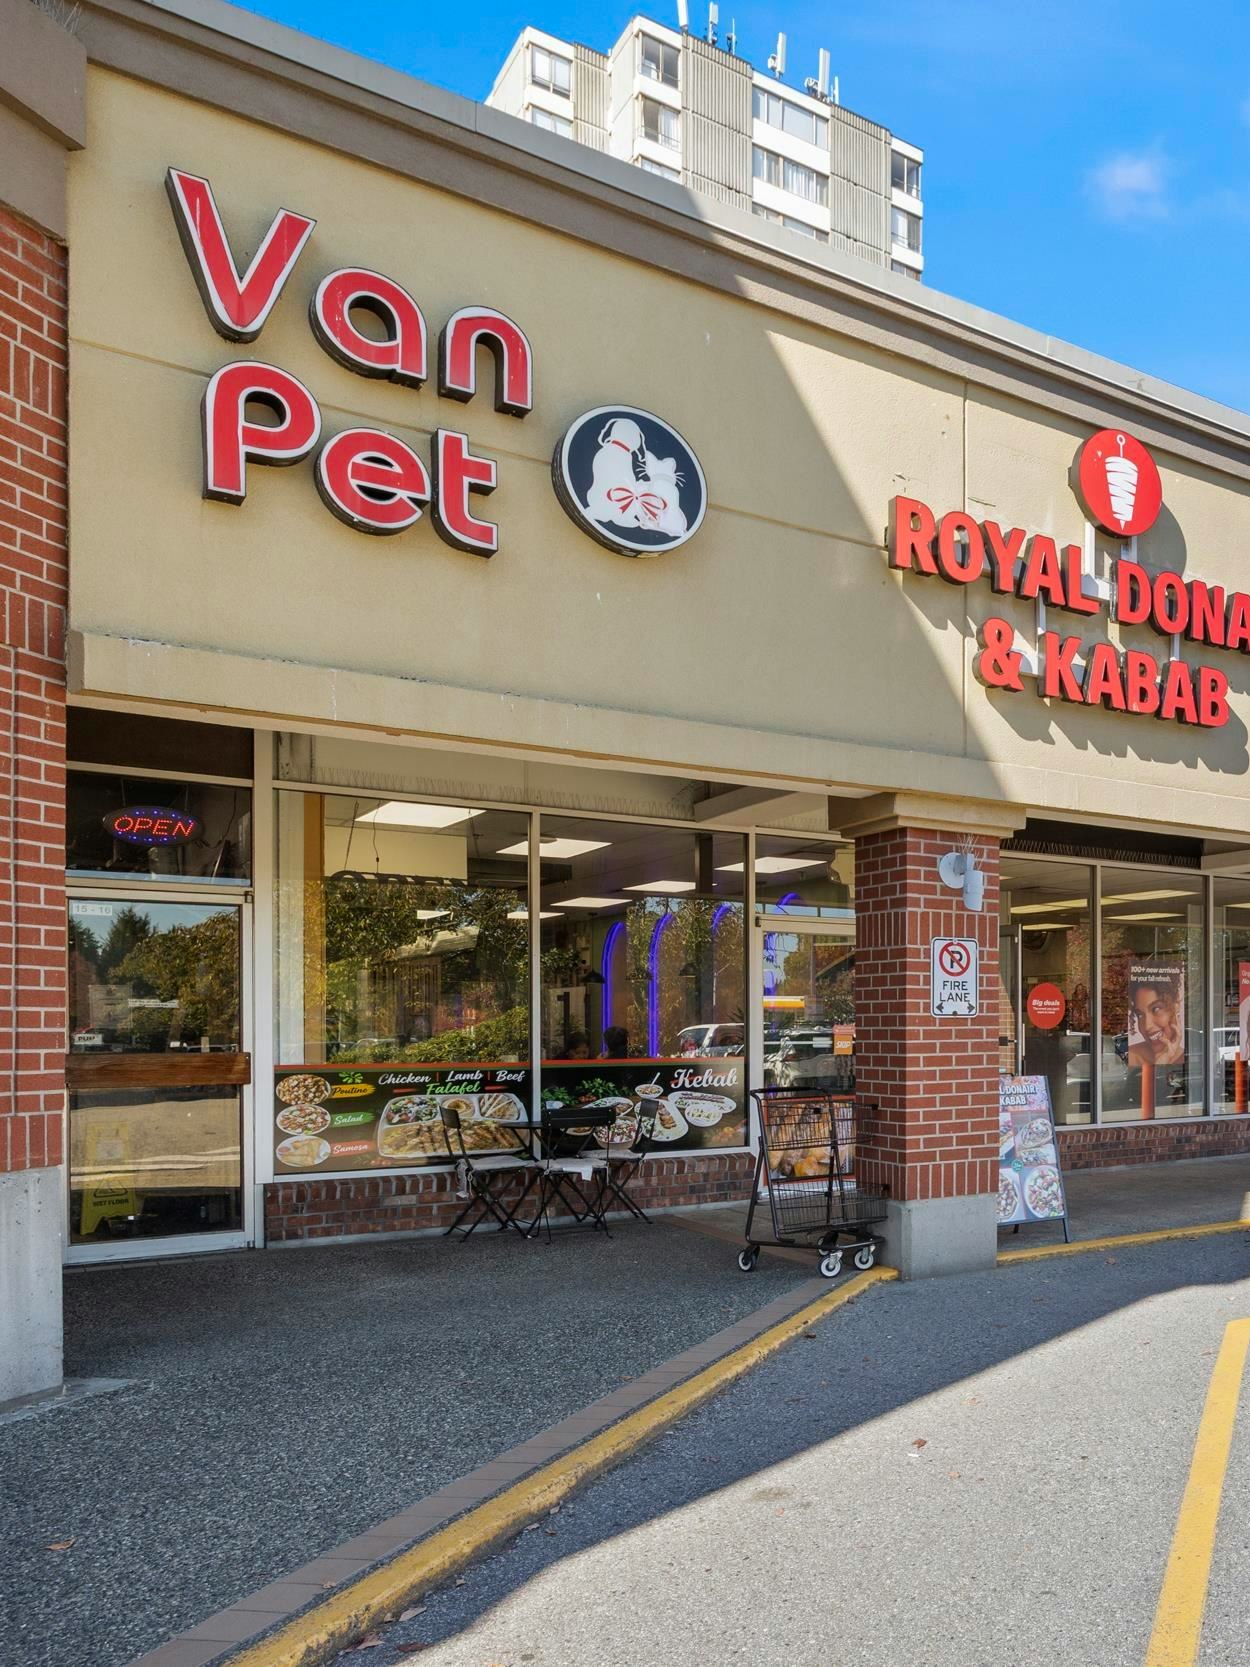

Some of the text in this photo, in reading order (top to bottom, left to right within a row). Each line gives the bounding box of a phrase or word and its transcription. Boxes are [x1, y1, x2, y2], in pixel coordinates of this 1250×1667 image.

[164, 167, 533, 419] Van
[201, 361, 498, 558] Pet
[889, 496, 1099, 616] ROYAL
[973, 618, 1229, 727] & KABAB
[114, 817, 195, 836] OPEN
[942, 981, 968, 991] FIRE
[940, 992, 970, 1002] LANE
[378, 1070, 526, 1085] Chicken Lamb Beef
[671, 1067, 739, 1089] Kebab
[332, 1085, 368, 1095] Poutine
[426, 1080, 480, 1096] Falafel
[333, 1115, 363, 1125] Salad
